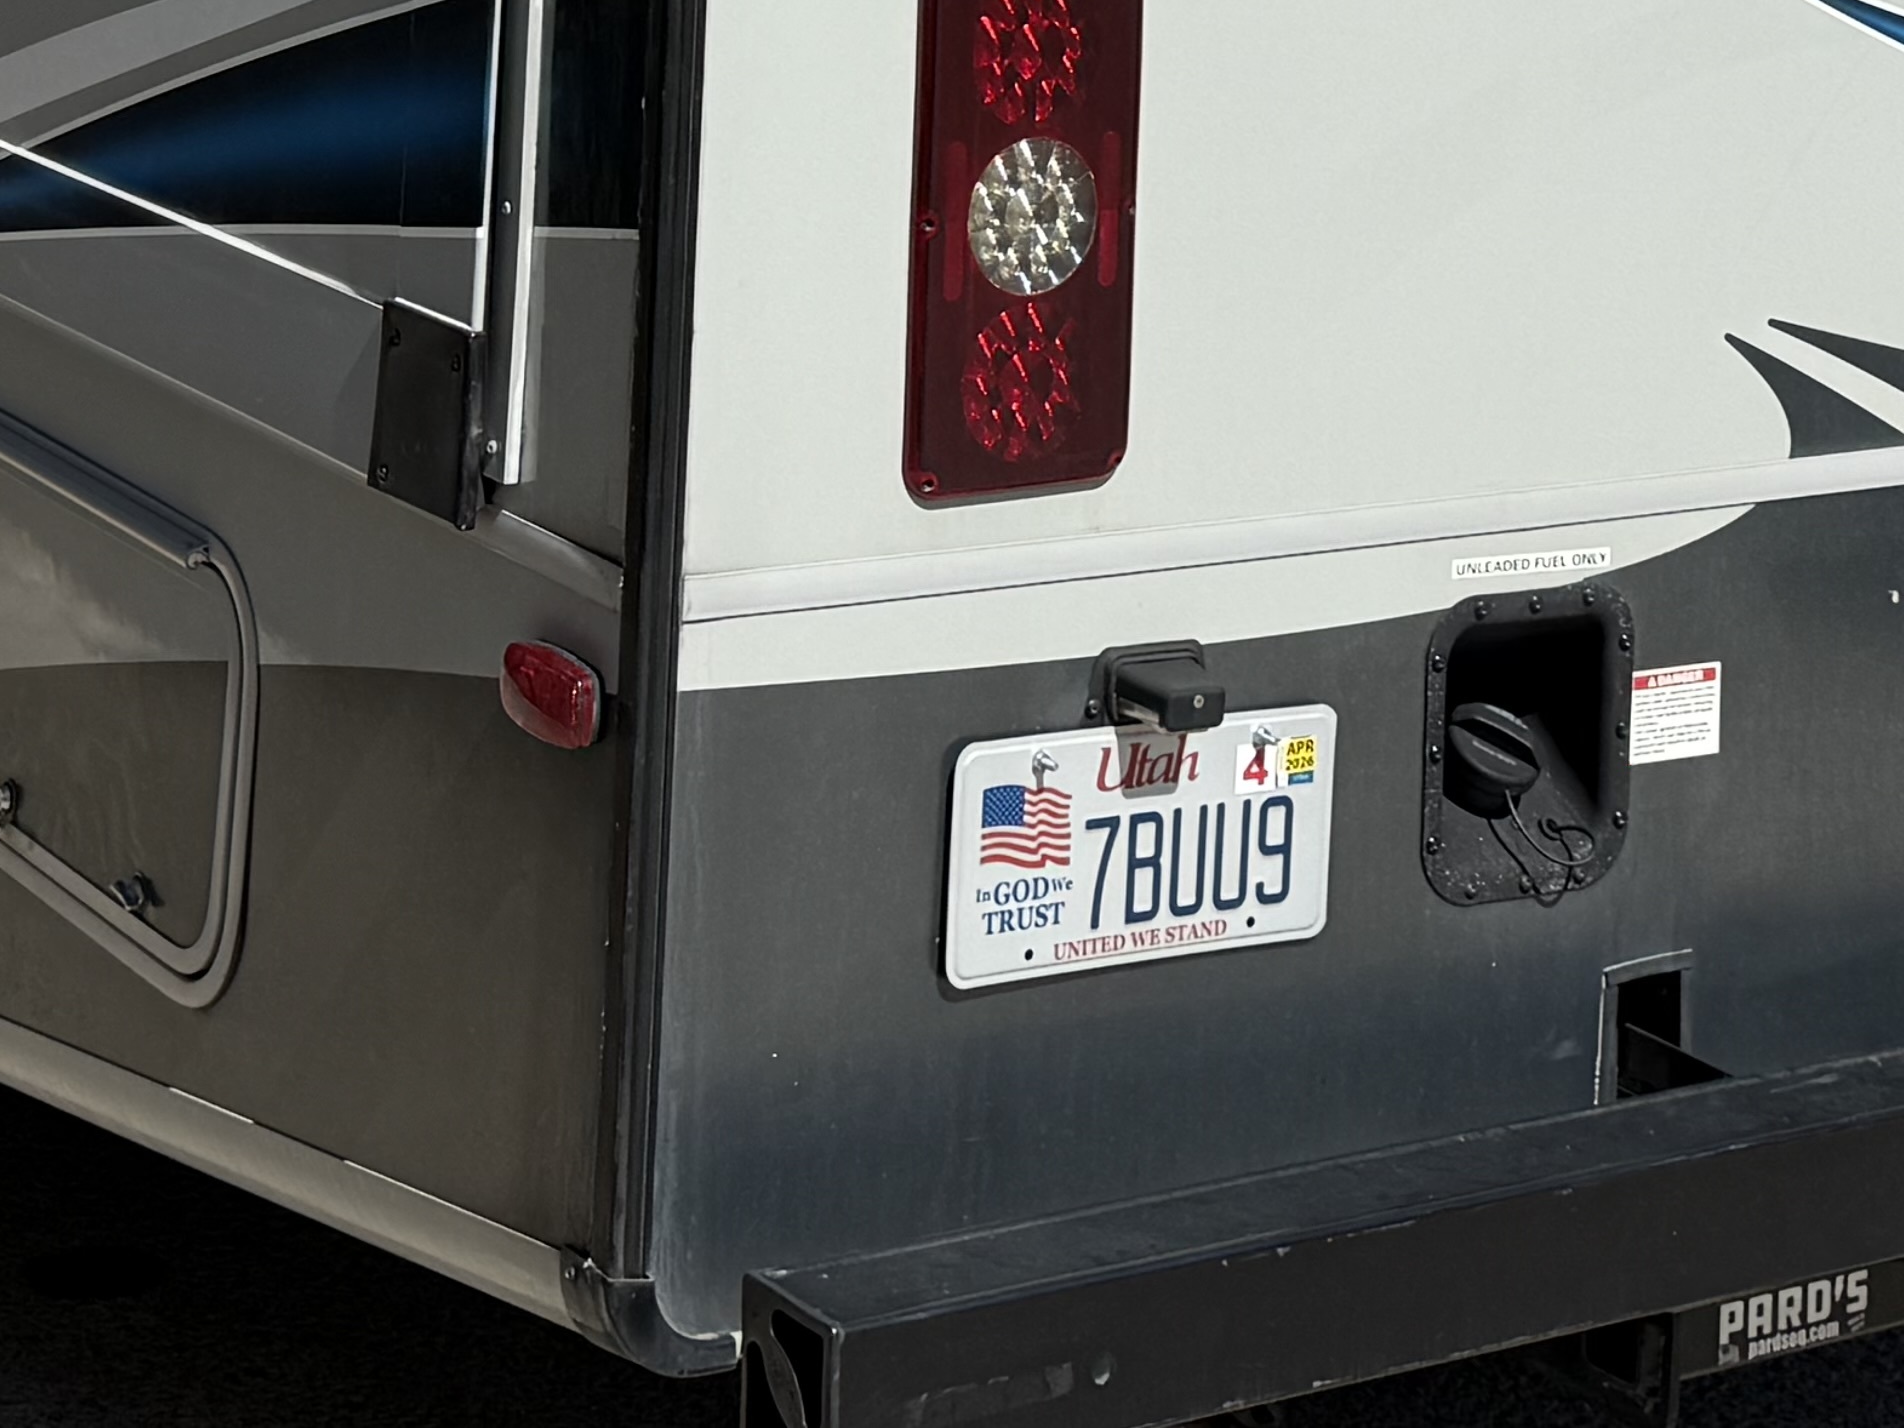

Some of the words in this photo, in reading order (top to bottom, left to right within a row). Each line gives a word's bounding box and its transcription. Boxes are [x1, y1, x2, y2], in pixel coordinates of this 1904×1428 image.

[1456, 557, 1530, 576] UNLEADED
[1534, 555, 1567, 568] FUEL
[1571, 551, 1607, 566] ONLY
[1097, 734, 1200, 791] Utah
[1243, 744, 1269, 786] 4
[1286, 738, 1315, 756] APR
[1085, 795, 1294, 930] 7BUU9
[976, 888, 991, 903] In
[993, 876, 1048, 907] GOD
[1051, 876, 1074, 893] We
[982, 901, 1065, 936] TRUST
[1053, 935, 1126, 962] UNITED
[1130, 929, 1161, 949] WE
[1164, 919, 1228, 945] STAND
[1718, 1269, 1869, 1346] PARD'S
